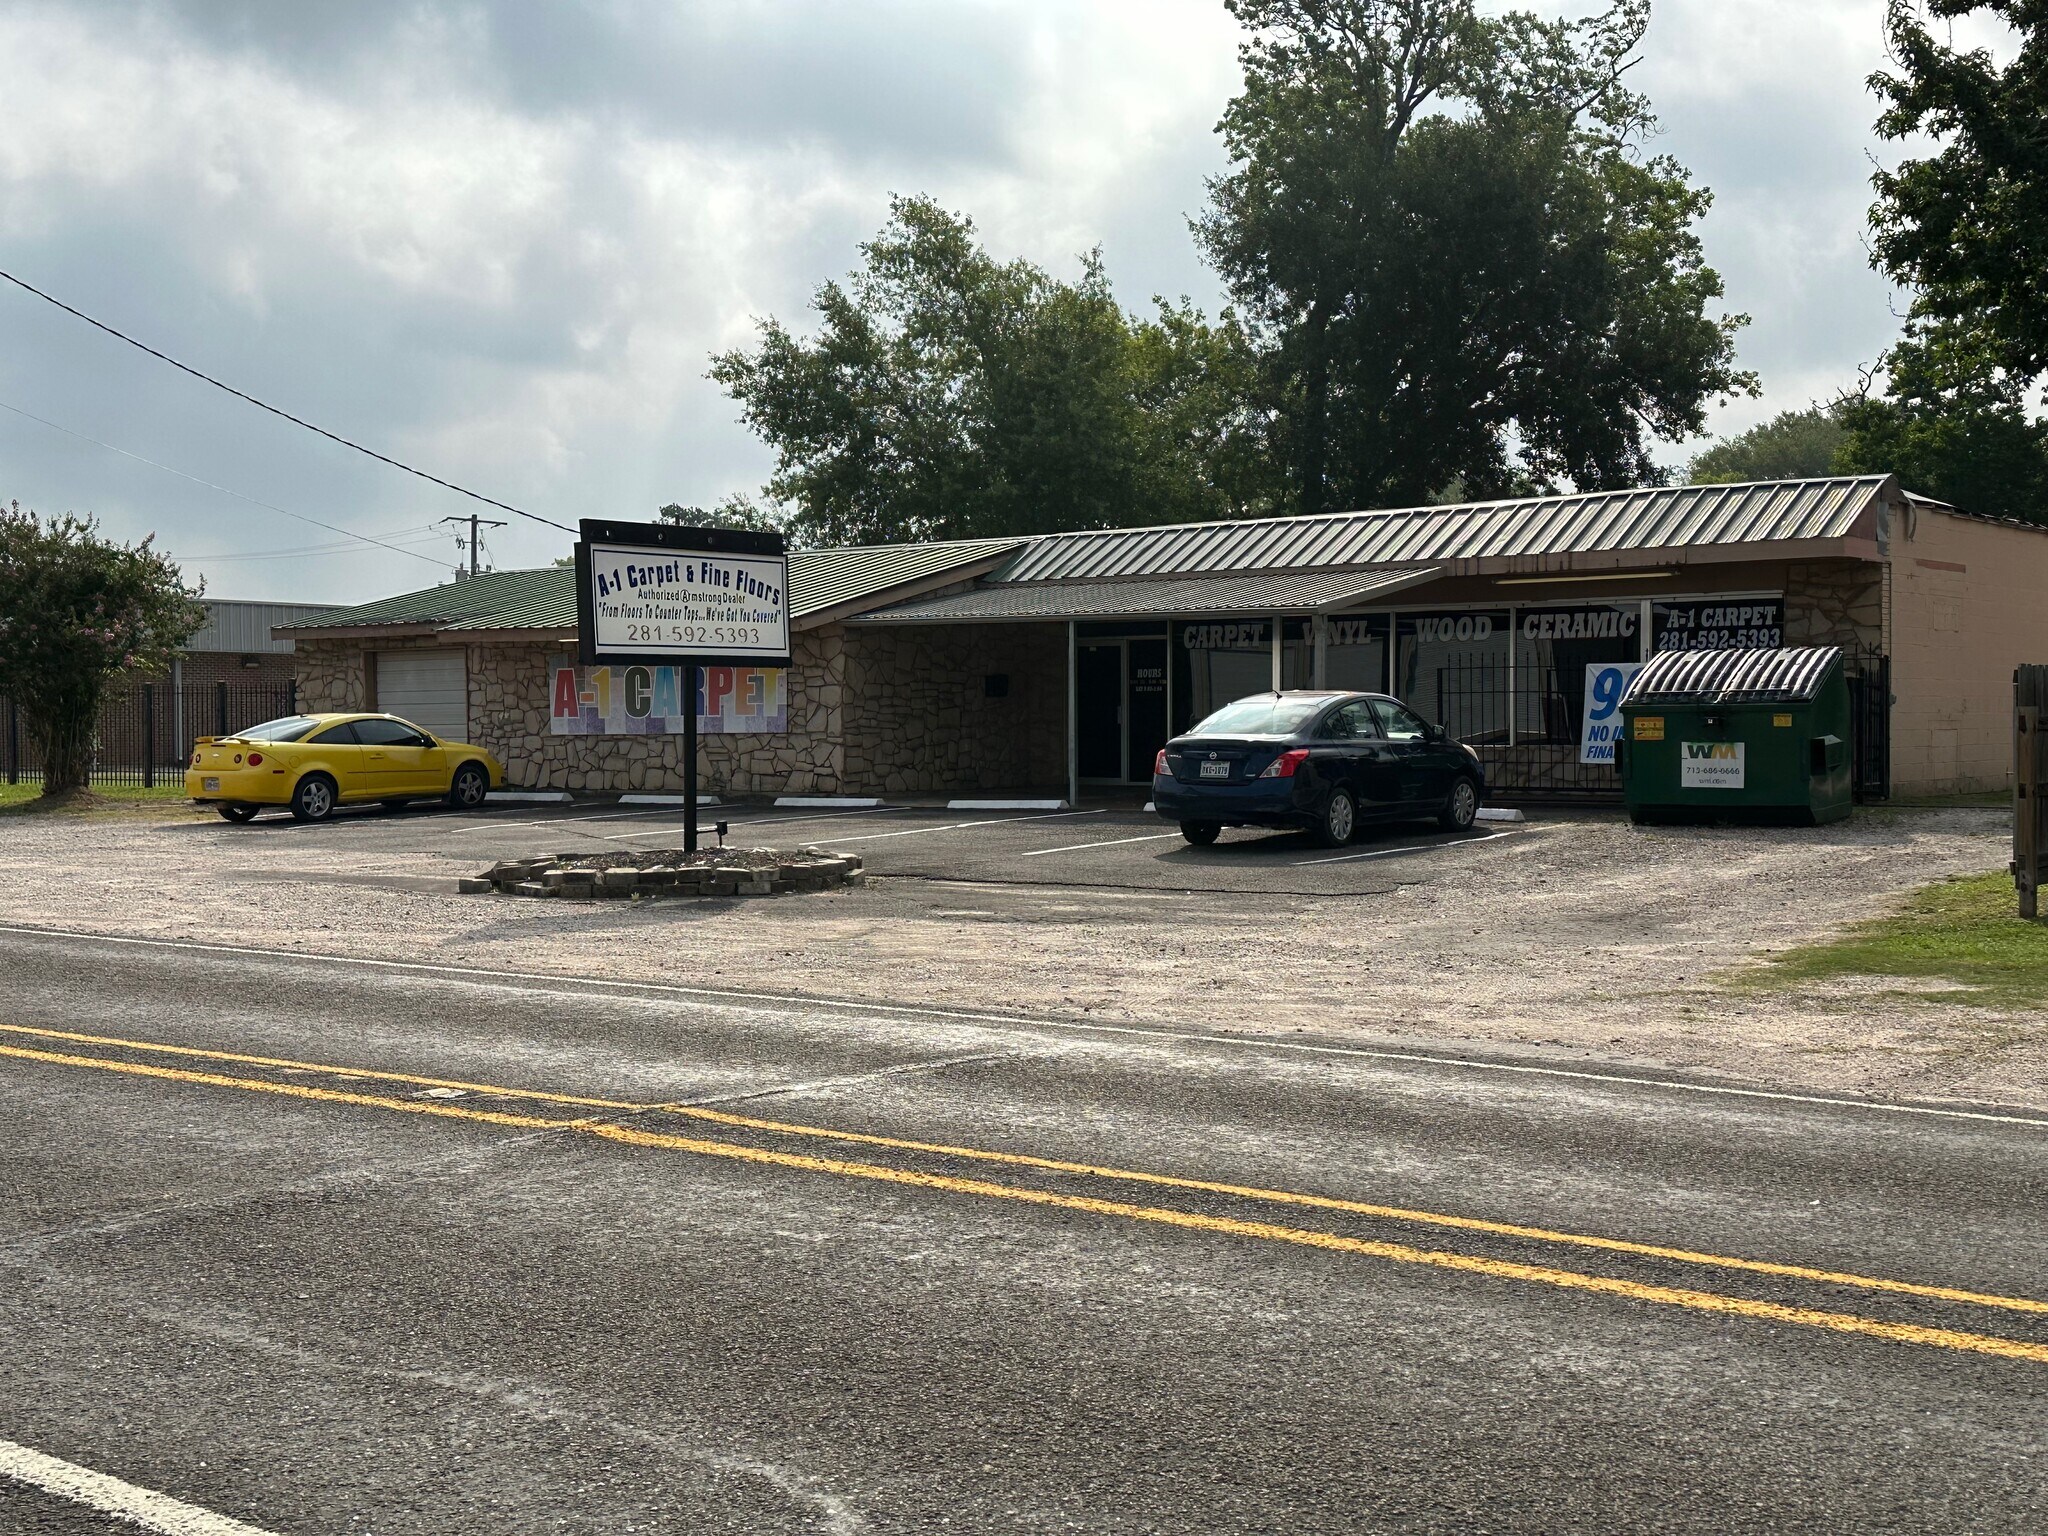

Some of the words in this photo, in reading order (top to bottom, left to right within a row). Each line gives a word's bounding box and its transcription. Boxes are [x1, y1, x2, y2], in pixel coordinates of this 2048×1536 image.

[598, 569, 621, 597] A-1
[627, 560, 679, 588] Carpet
[686, 565, 694, 583] &
[701, 562, 729, 588] Fine
[736, 569, 780, 605] Floors
[638, 588, 680, 601] Authorized
[680, 589, 722, 605] Armstrong
[722, 592, 745, 604] Dealer
[620, 603, 642, 619] Floors
[645, 604, 653, 618] To
[655, 604, 681, 620] Counter
[726, 607, 738, 621] Got
[740, 608, 751, 622] You
[1666, 608, 1695, 628] A-1
[1701, 606, 1777, 627] CARPET
[627, 624, 760, 643] 281-592-5393
[1184, 624, 1264, 649] CARPET
[1415, 616, 1492, 642] WOOD
[1523, 611, 1636, 640] CERAMIC
[1659, 628, 1780, 650] 281-592-5393
[1137, 668, 1162, 678] HOURS
[553, 668, 612, 718] A-1
[1588, 725, 1609, 742] NO
[1687, 744, 1737, 759] WM
